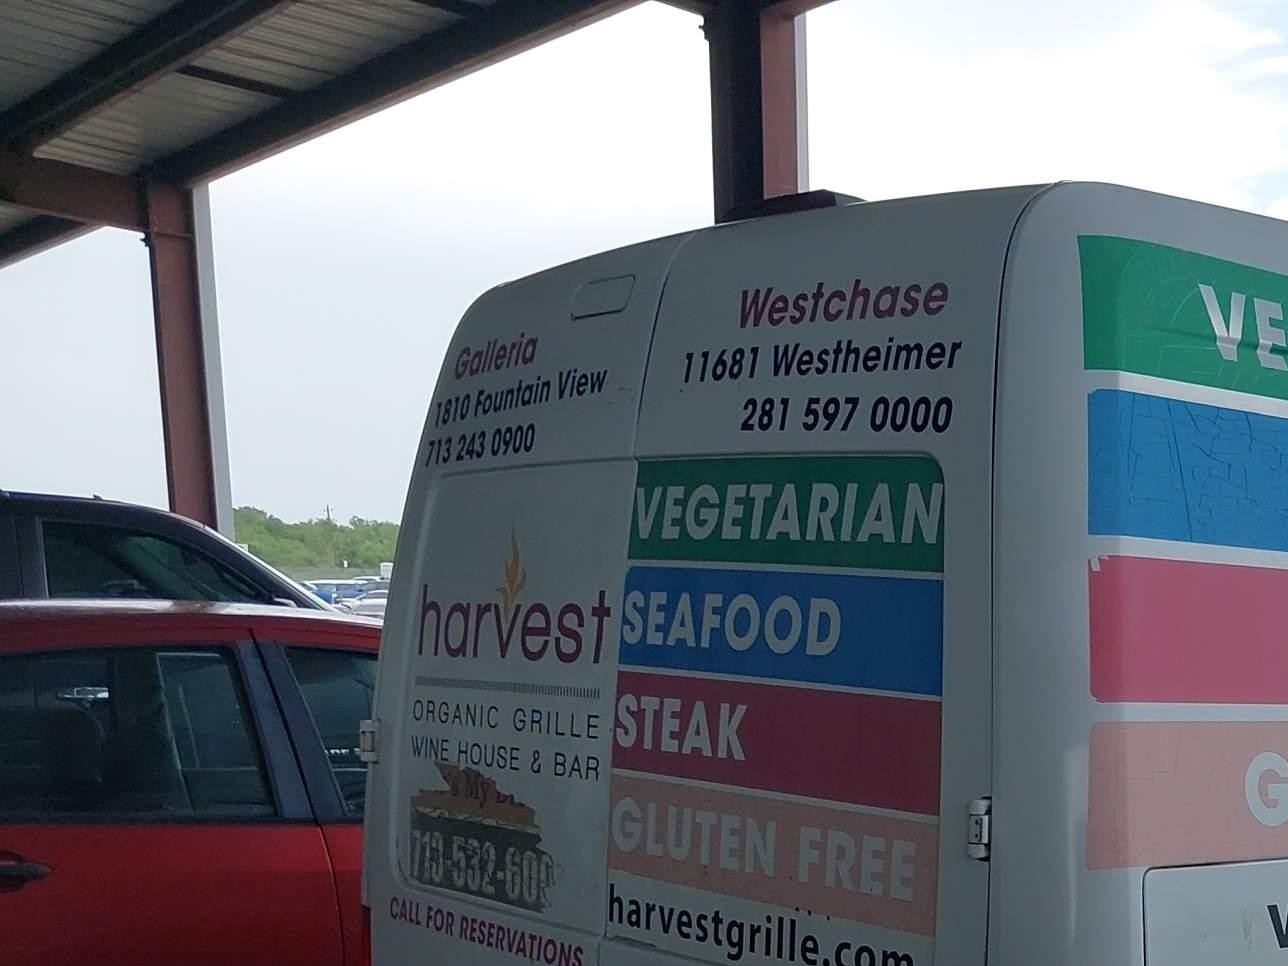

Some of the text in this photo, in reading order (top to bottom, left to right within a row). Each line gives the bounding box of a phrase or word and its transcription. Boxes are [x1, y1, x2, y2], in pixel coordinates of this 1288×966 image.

[739, 281, 949, 329] Westchase
[454, 333, 538, 380] Galleria
[683, 339, 961, 383] 11681 Westheimer
[434, 367, 608, 428] 1810 Fountain View
[740, 397, 953, 433] 281 597 0000
[425, 423, 535, 467] 713 243 0900
[635, 482, 943, 545] VEGETARIAN
[417, 584, 611, 664] harvest
[622, 590, 842, 655] SEAFOOD
[412, 699, 600, 739] ORGANIC GRILLE
[616, 693, 748, 761] STEAK
[411, 736, 600, 781] WINE HOUSE & BAR
[612, 796, 916, 901] GLUTEN FREE
[390, 897, 421, 926] CALL
[427, 906, 455, 936] FOR
